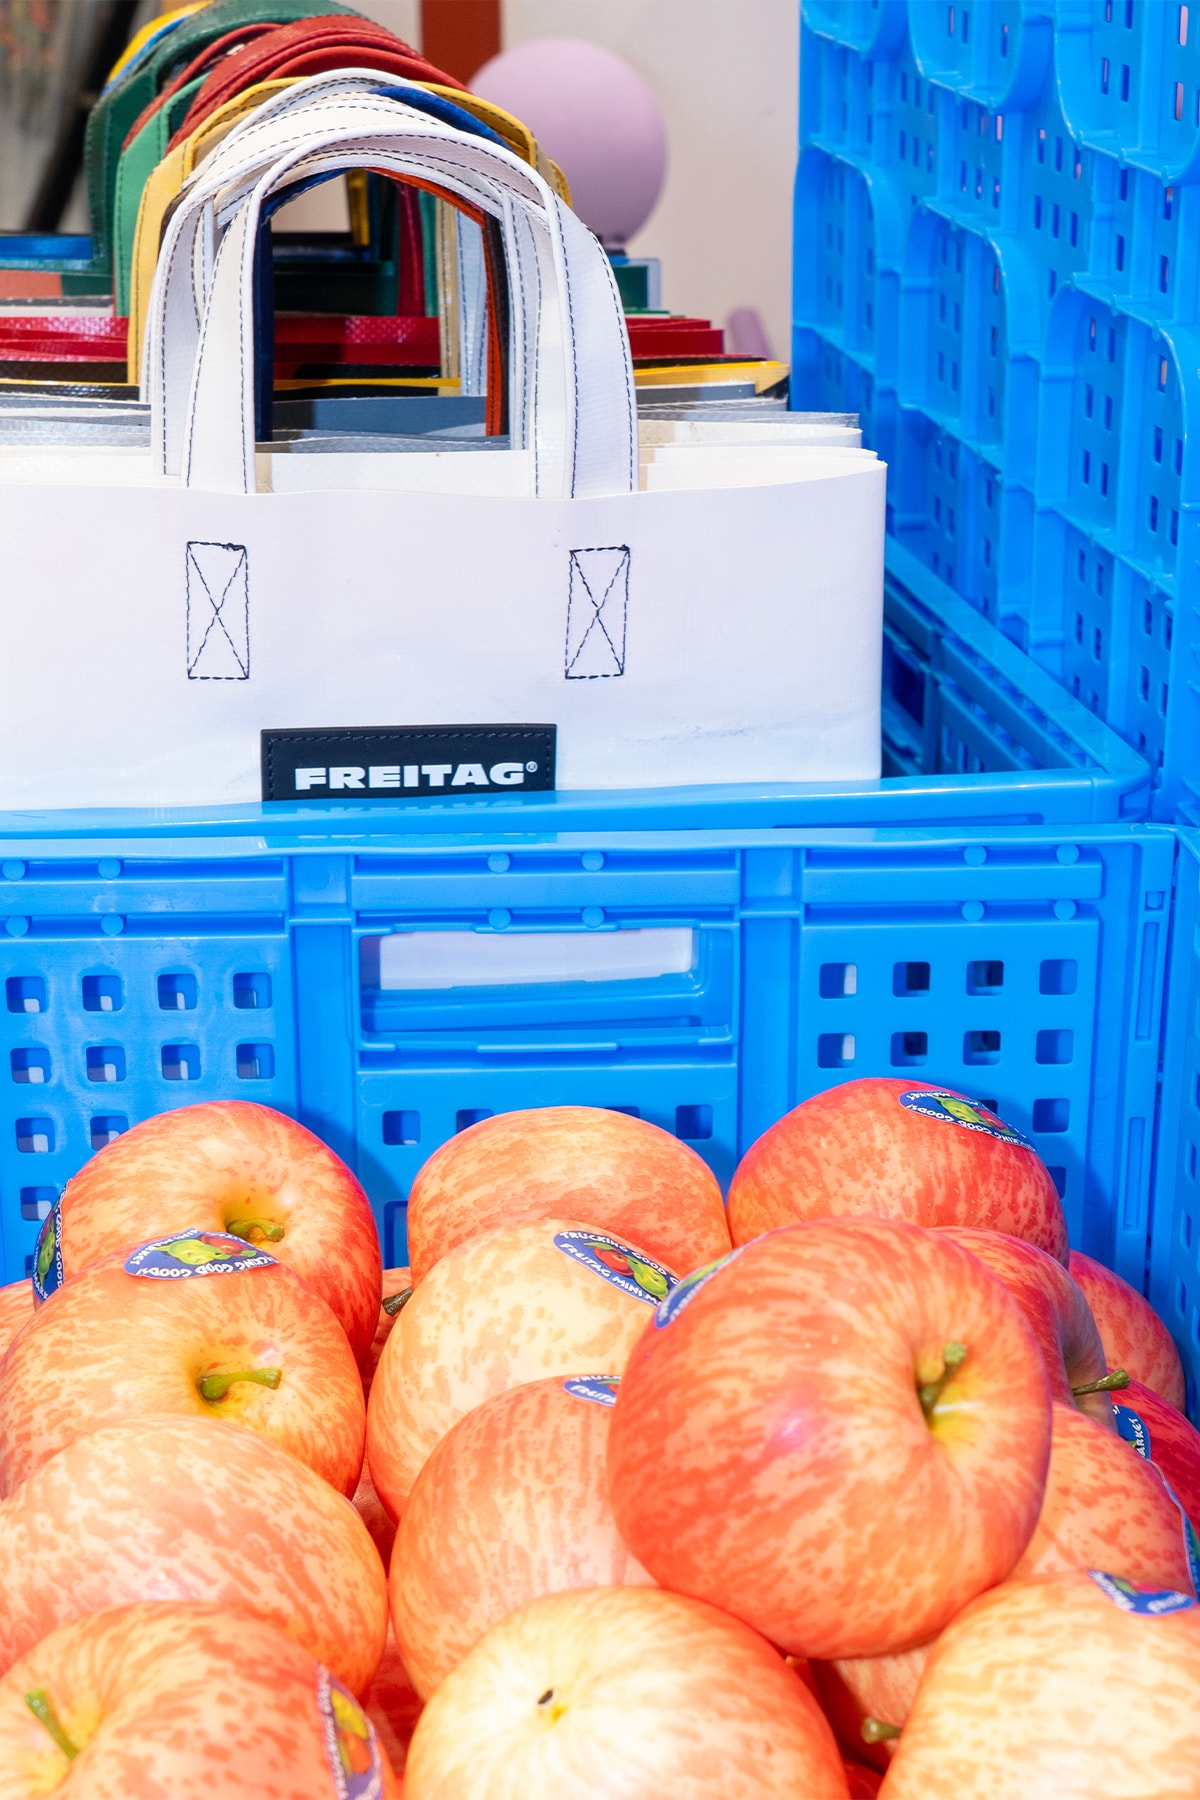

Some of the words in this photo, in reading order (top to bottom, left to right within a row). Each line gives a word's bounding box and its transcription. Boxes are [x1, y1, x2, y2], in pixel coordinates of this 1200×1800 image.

[907, 1103, 955, 1122] GOODS!
[958, 1120, 992, 1135] GOOD
[559, 1231, 628, 1253] TRUCKING
[631, 1250, 667, 1276] GOOD
[136, 1266, 192, 1278] GOODS!
[194, 1263, 234, 1276] GOOD
[560, 1242, 610, 1278] FREITAG
[612, 1275, 643, 1297] MINI
[1127, 1417, 1147, 1459] ARKET
